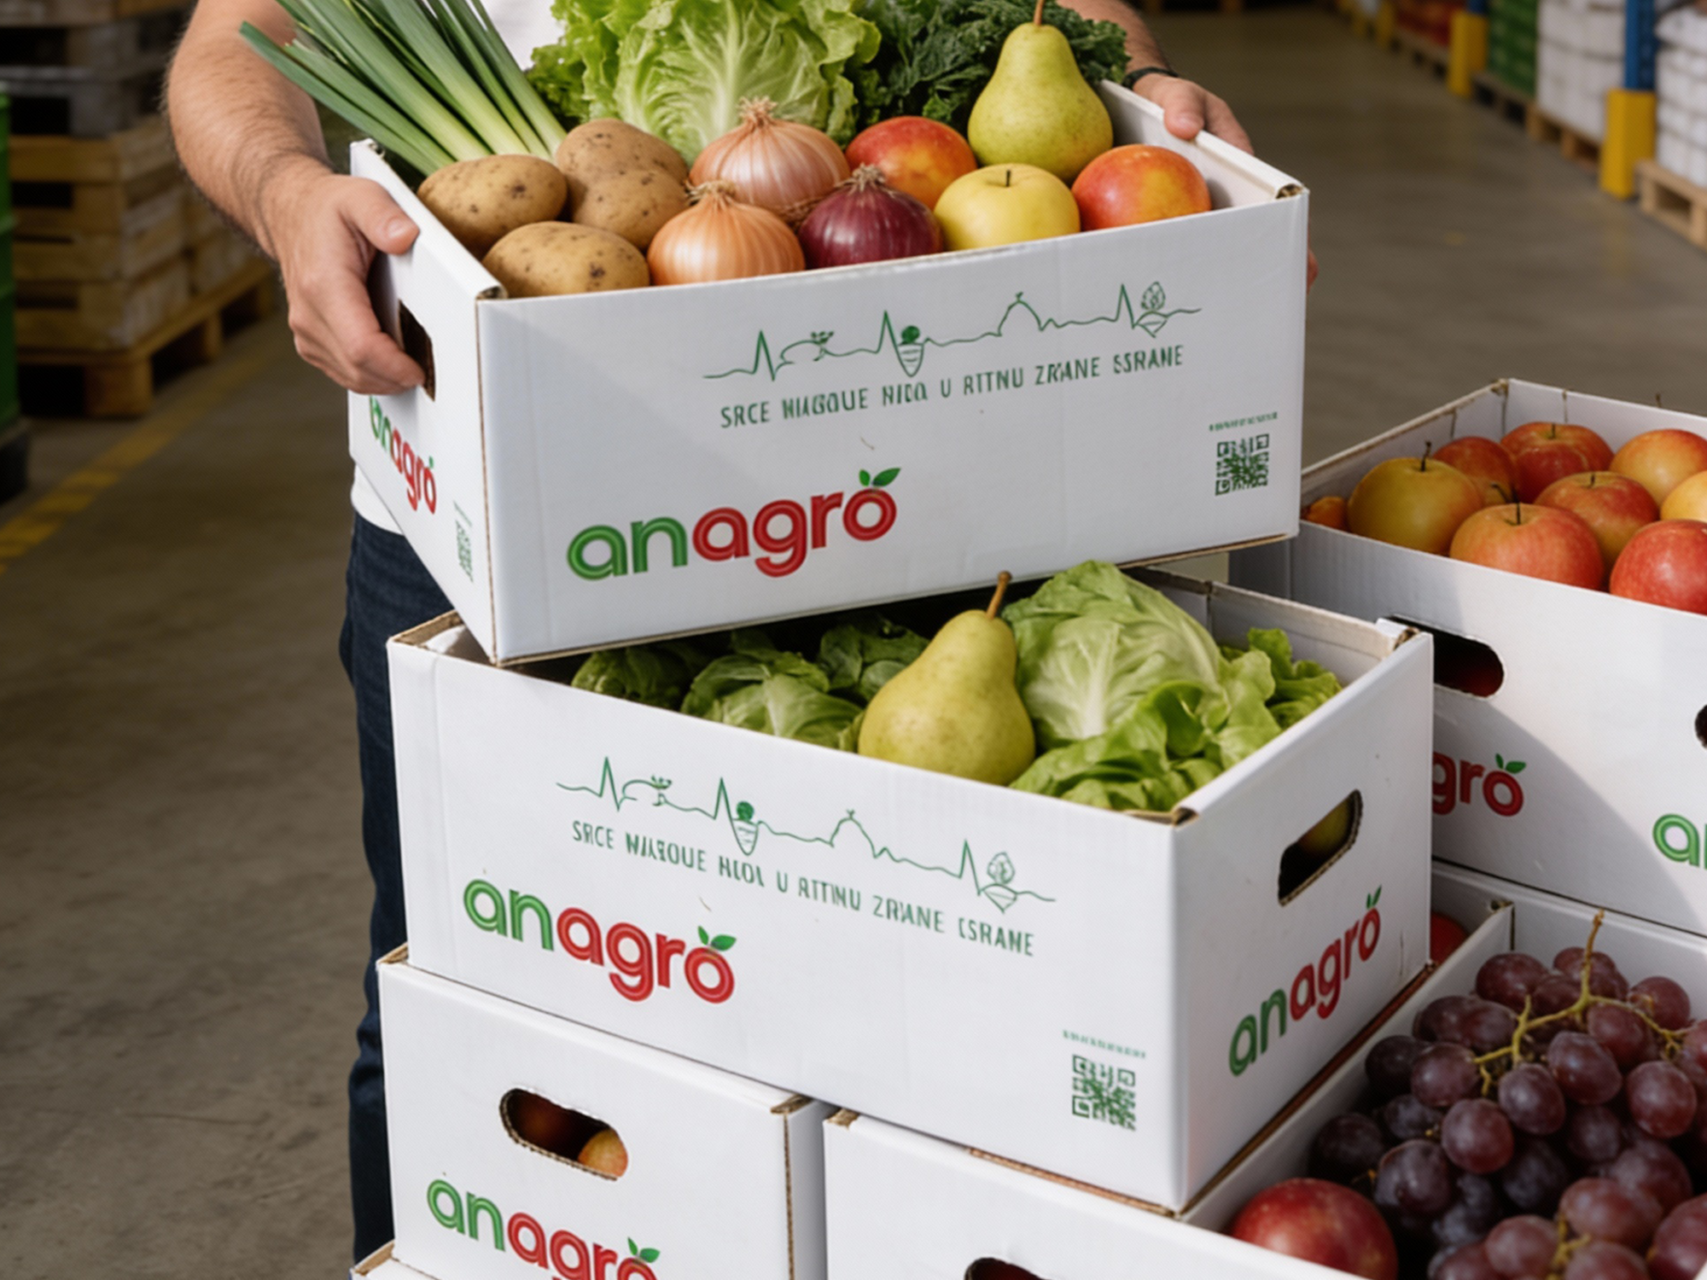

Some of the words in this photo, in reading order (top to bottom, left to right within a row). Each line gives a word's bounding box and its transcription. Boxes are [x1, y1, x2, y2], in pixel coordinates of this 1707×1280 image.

[370, 395, 437, 514] anagro
[720, 400, 769, 428] SRCE
[940, 379, 951, 398] U
[566, 487, 898, 581] anagro
[572, 820, 614, 849] SRCE
[776, 871, 789, 893] U
[462, 878, 736, 1004] anagro
[1229, 908, 1381, 1077] anagro
